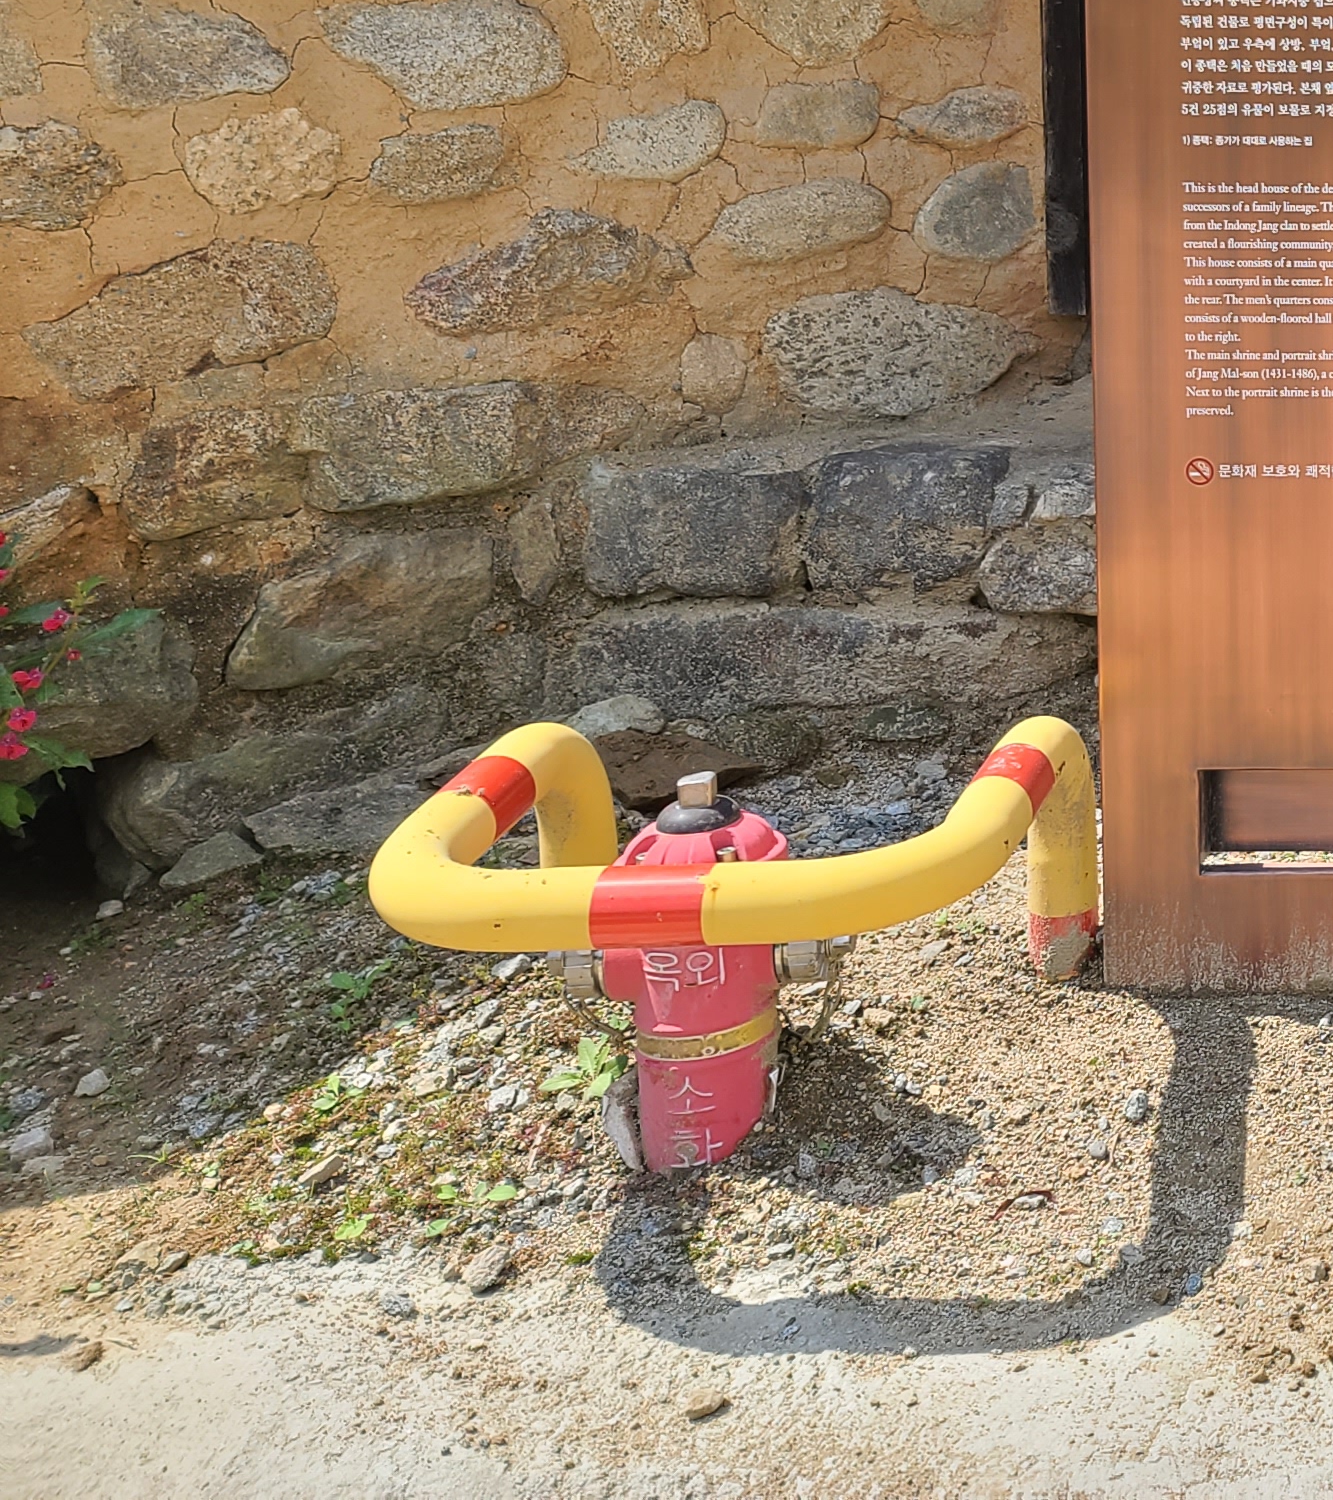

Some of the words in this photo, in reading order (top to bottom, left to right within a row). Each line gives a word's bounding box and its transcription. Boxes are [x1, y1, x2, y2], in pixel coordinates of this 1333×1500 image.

[1182, 181, 1205, 192] This
[1217, 181, 1234, 193] the
[1235, 181, 1259, 193] head
[1260, 182, 1289, 193] house
[1290, 182, 1303, 193] of
[1303, 182, 1319, 193] the
[1185, 404, 1233, 418] preserved.
[1218, 463, 1256, 477] 문화재
[1261, 464, 1300, 478] 보호와
[643, 948, 726, 992] 옥외
[668, 1077, 722, 1168] 소화
